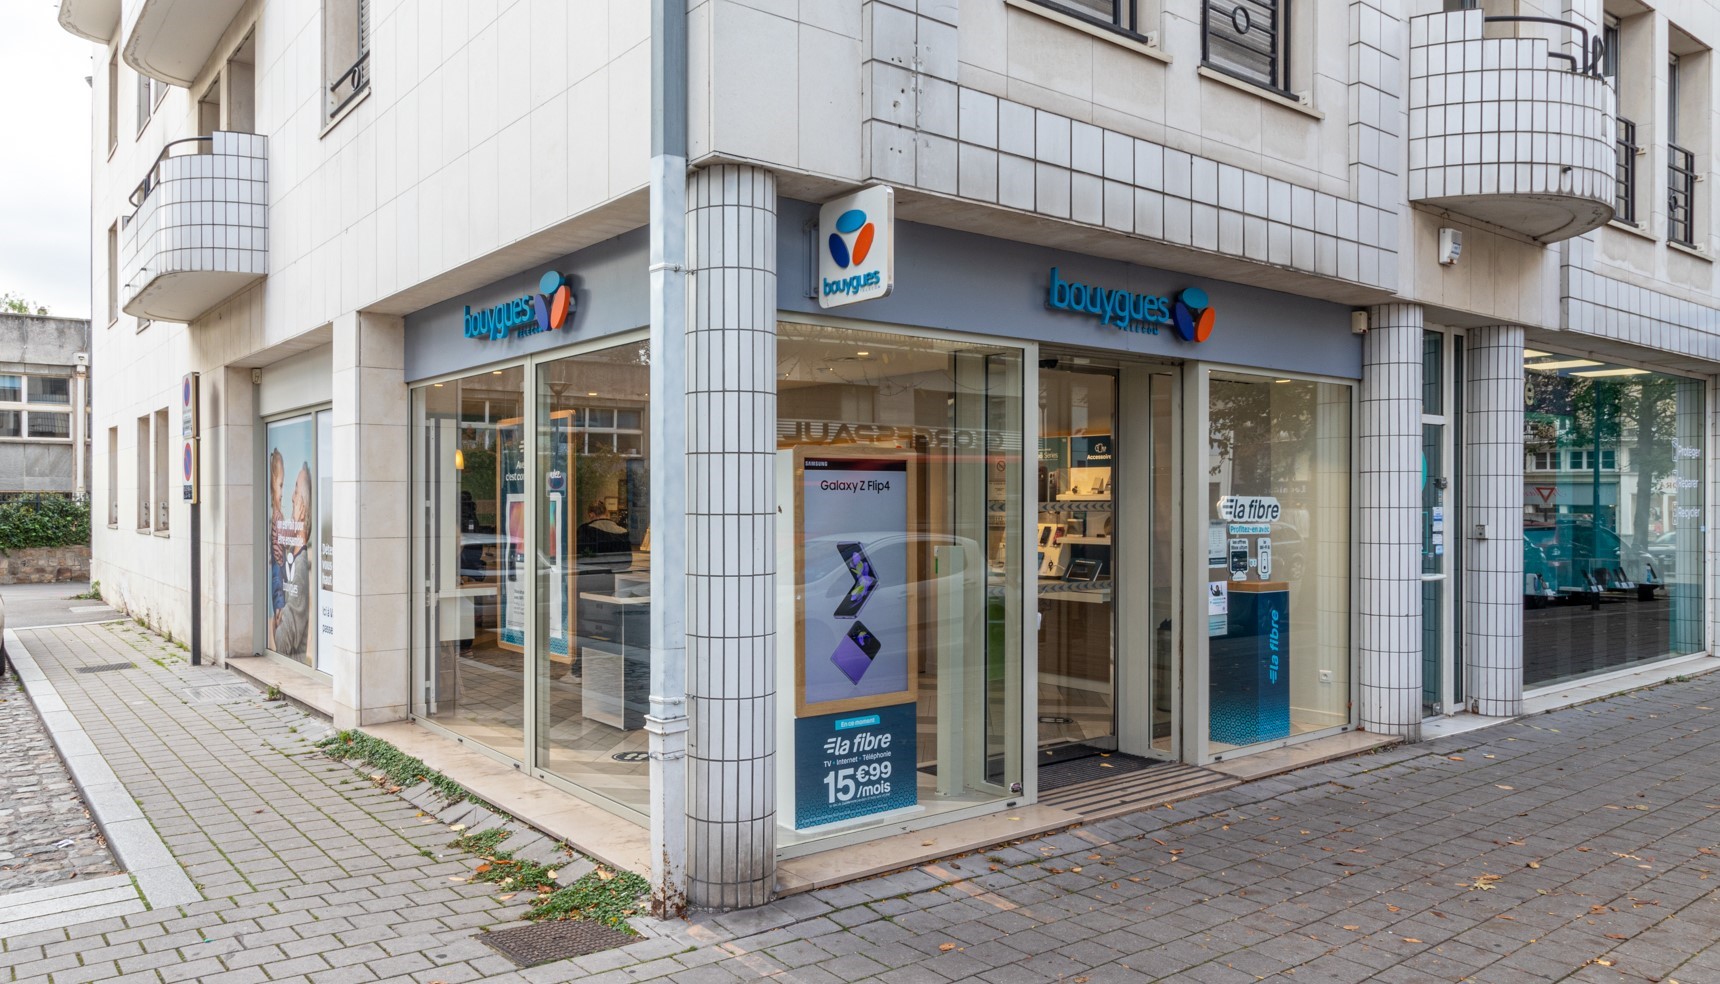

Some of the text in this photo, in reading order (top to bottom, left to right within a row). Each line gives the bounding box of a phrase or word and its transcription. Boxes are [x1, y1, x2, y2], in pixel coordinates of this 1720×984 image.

[823, 270, 881, 297] bouygues
[1049, 266, 1170, 327] bouygues
[464, 294, 534, 341] bouygues
[820, 480, 890, 494] Galaxy Z Flip4
[1233, 499, 1280, 519] la fibre
[1270, 609, 1279, 670] la fibre
[855, 717, 875, 725] moment
[835, 732, 891, 756] la fibre
[836, 756, 858, 765] Internet
[862, 750, 891, 761] Téléphonie
